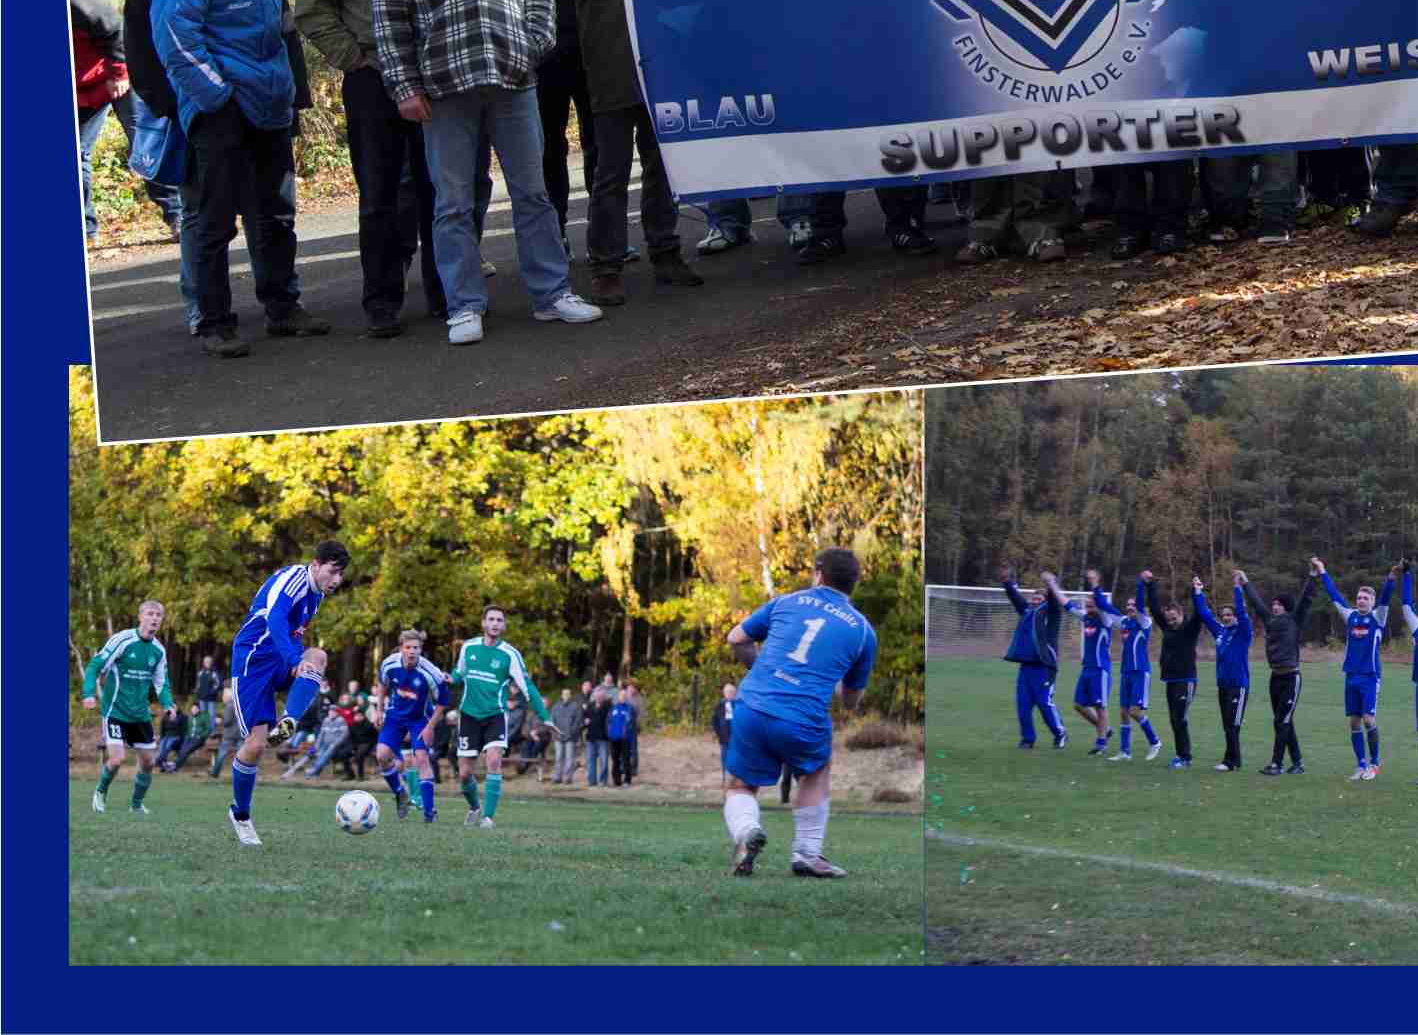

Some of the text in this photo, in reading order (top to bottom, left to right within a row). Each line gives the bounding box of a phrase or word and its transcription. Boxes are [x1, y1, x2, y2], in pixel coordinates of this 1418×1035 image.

[954, 34, 1124, 104] FINSTERWALDE
[655, 93, 776, 135] BLAU
[879, 103, 1247, 176] SUPPORTER
[786, 618, 826, 664] 1
